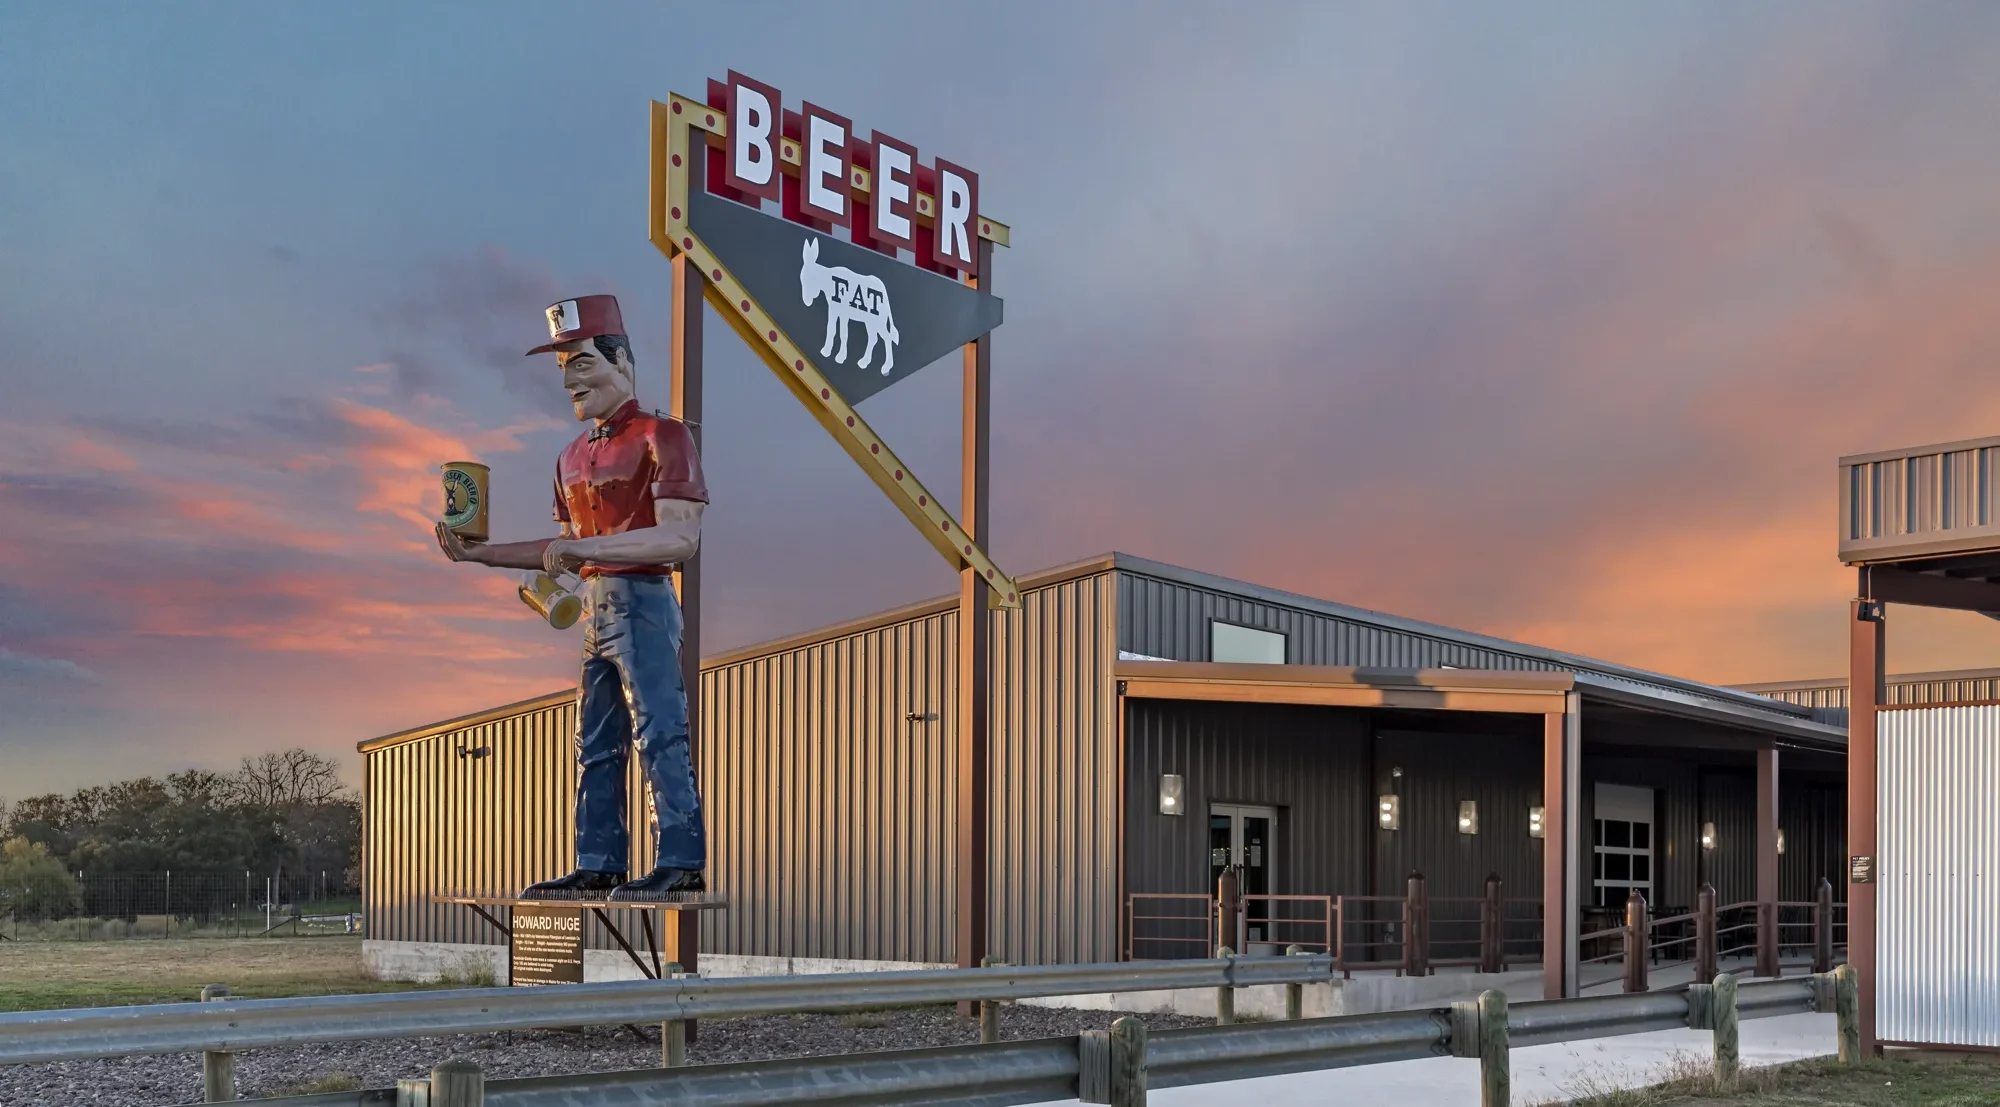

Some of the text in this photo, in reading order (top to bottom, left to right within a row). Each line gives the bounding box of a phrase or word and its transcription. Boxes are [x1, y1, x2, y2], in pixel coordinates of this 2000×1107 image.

[735, 83, 972, 264] BEER
[831, 275, 884, 317] FAT
[463, 478, 477, 496] BEER
[512, 915, 580, 931] HOWARD HUGE
